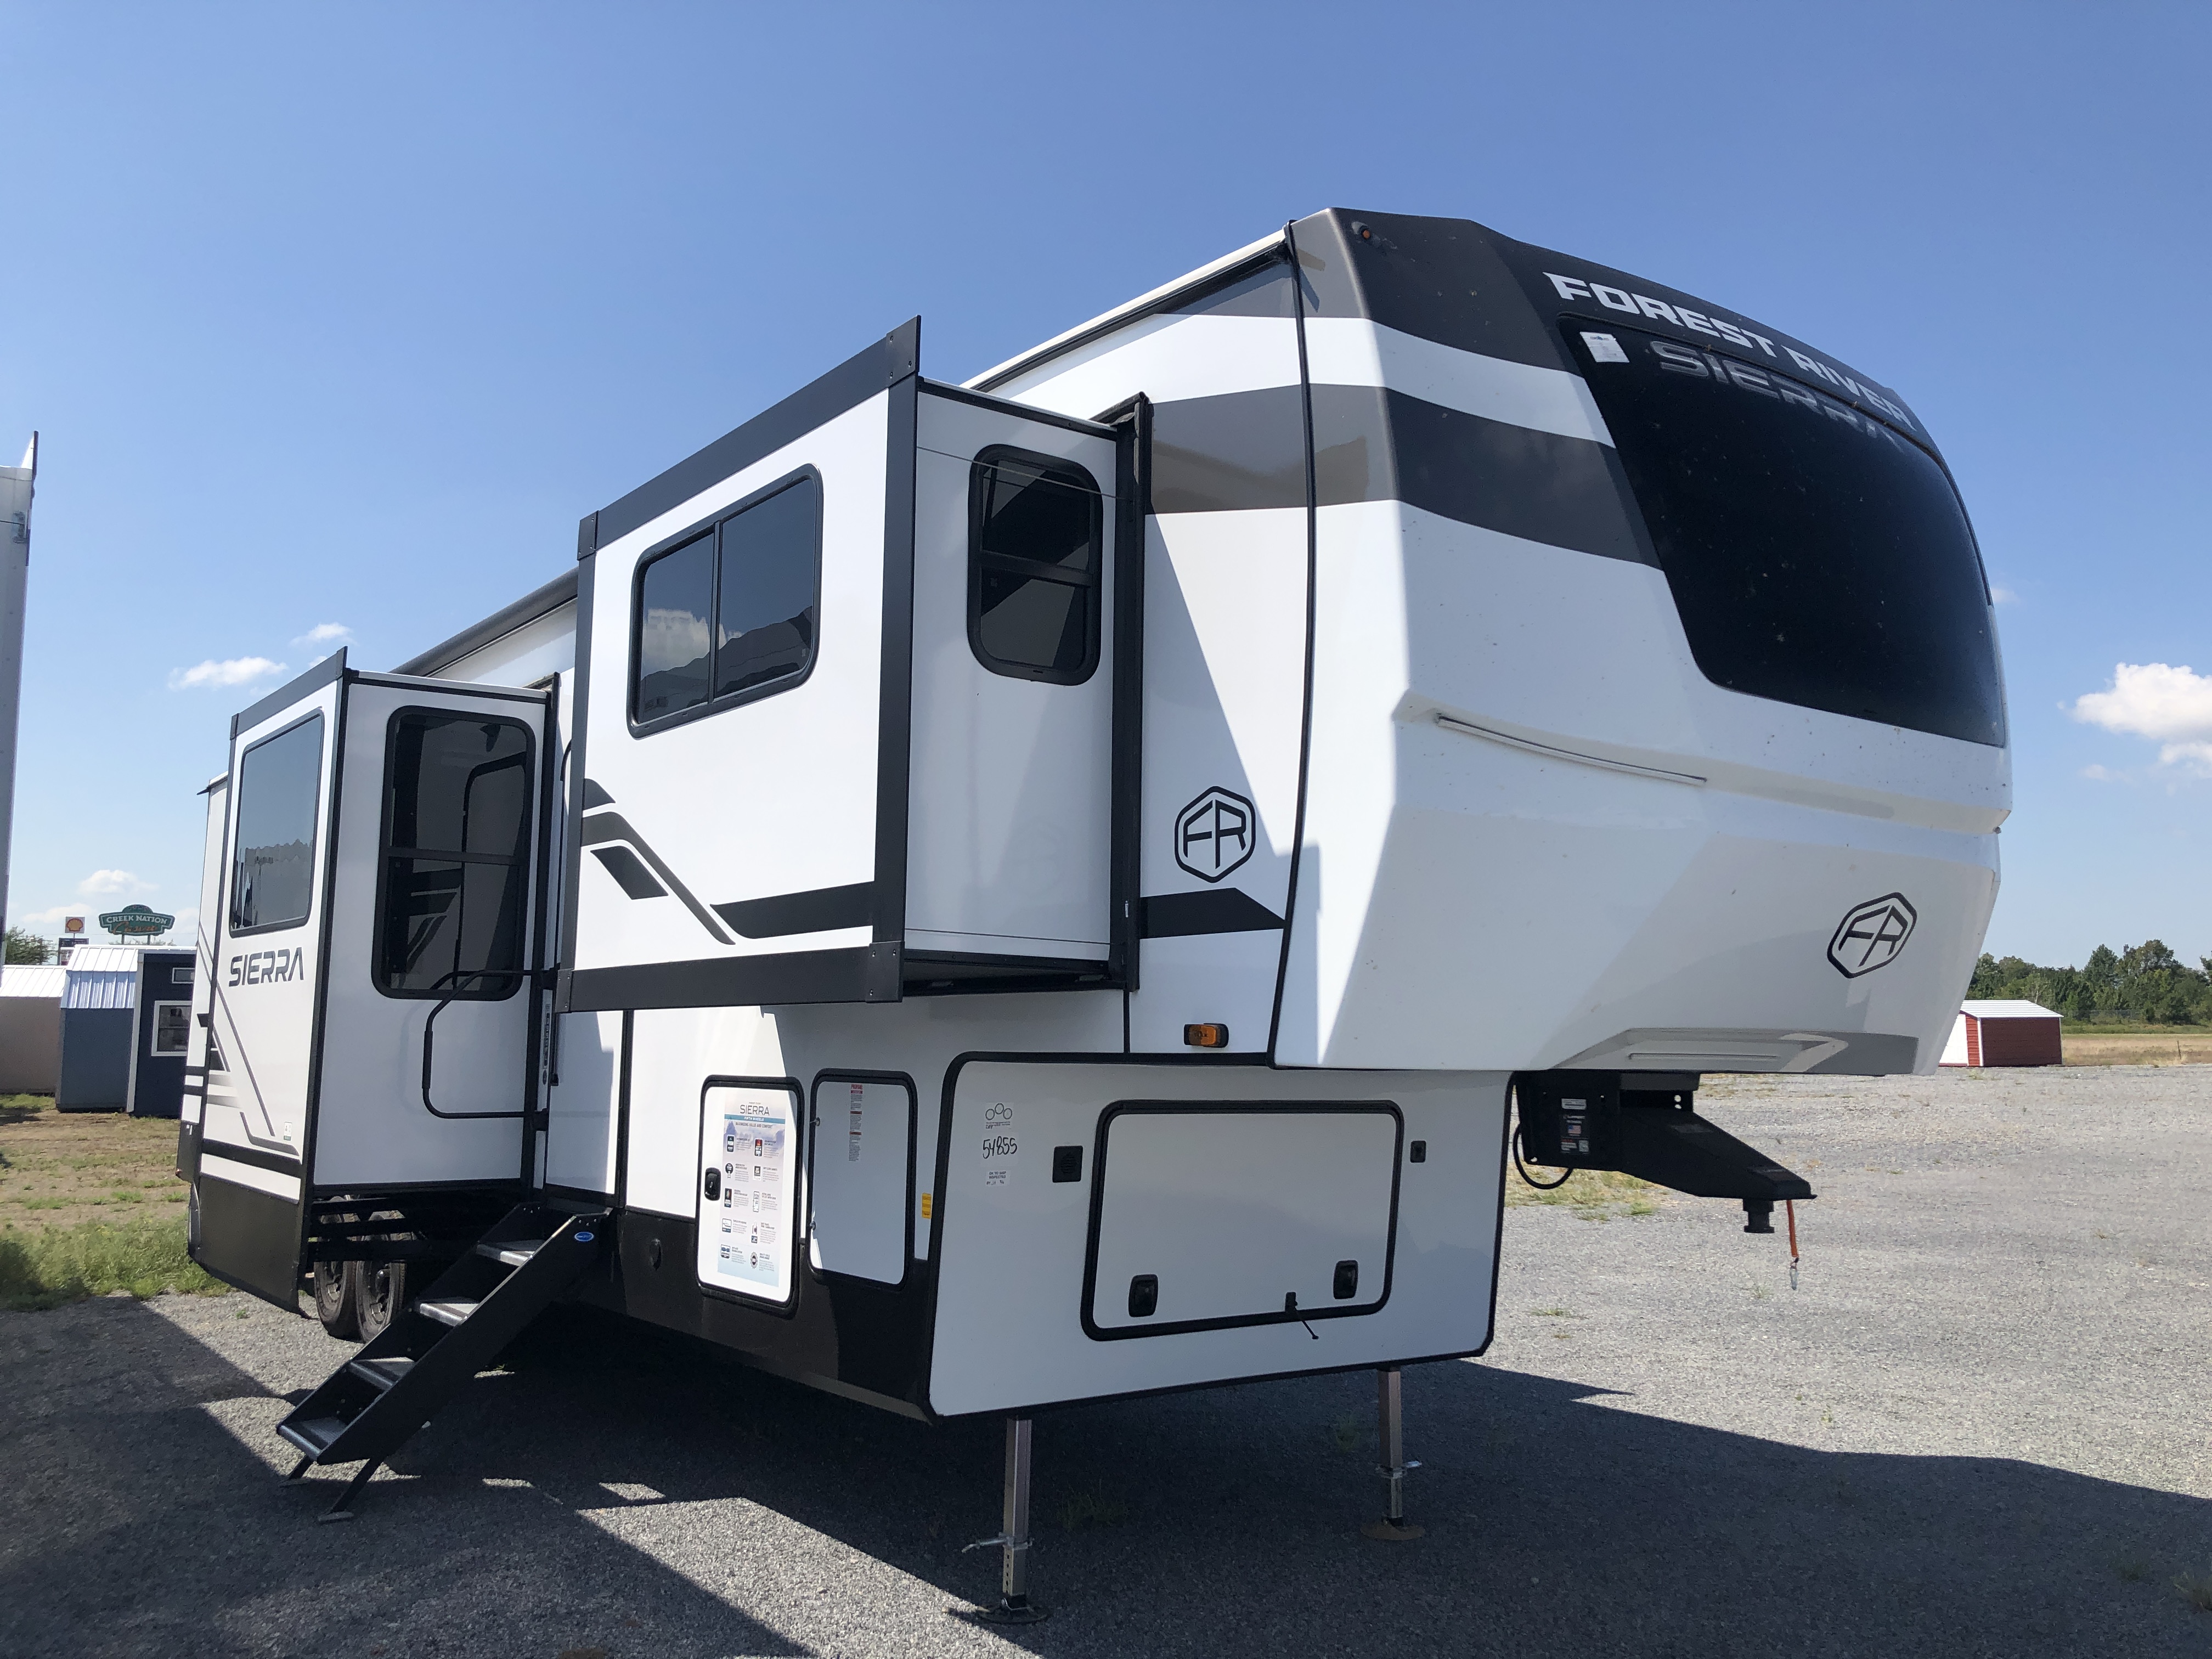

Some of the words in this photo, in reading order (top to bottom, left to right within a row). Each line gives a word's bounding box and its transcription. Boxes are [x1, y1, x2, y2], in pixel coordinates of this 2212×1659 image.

[1543, 271, 1778, 358] FOREST
[1780, 344, 1917, 432] RIVER
[106, 915, 134, 923] CREEK
[136, 915, 168, 924] NATION
[228, 946, 304, 988] SIERRA
[740, 1104, 770, 1116] SIERRA
[982, 1136, 1018, 1159] 54855
